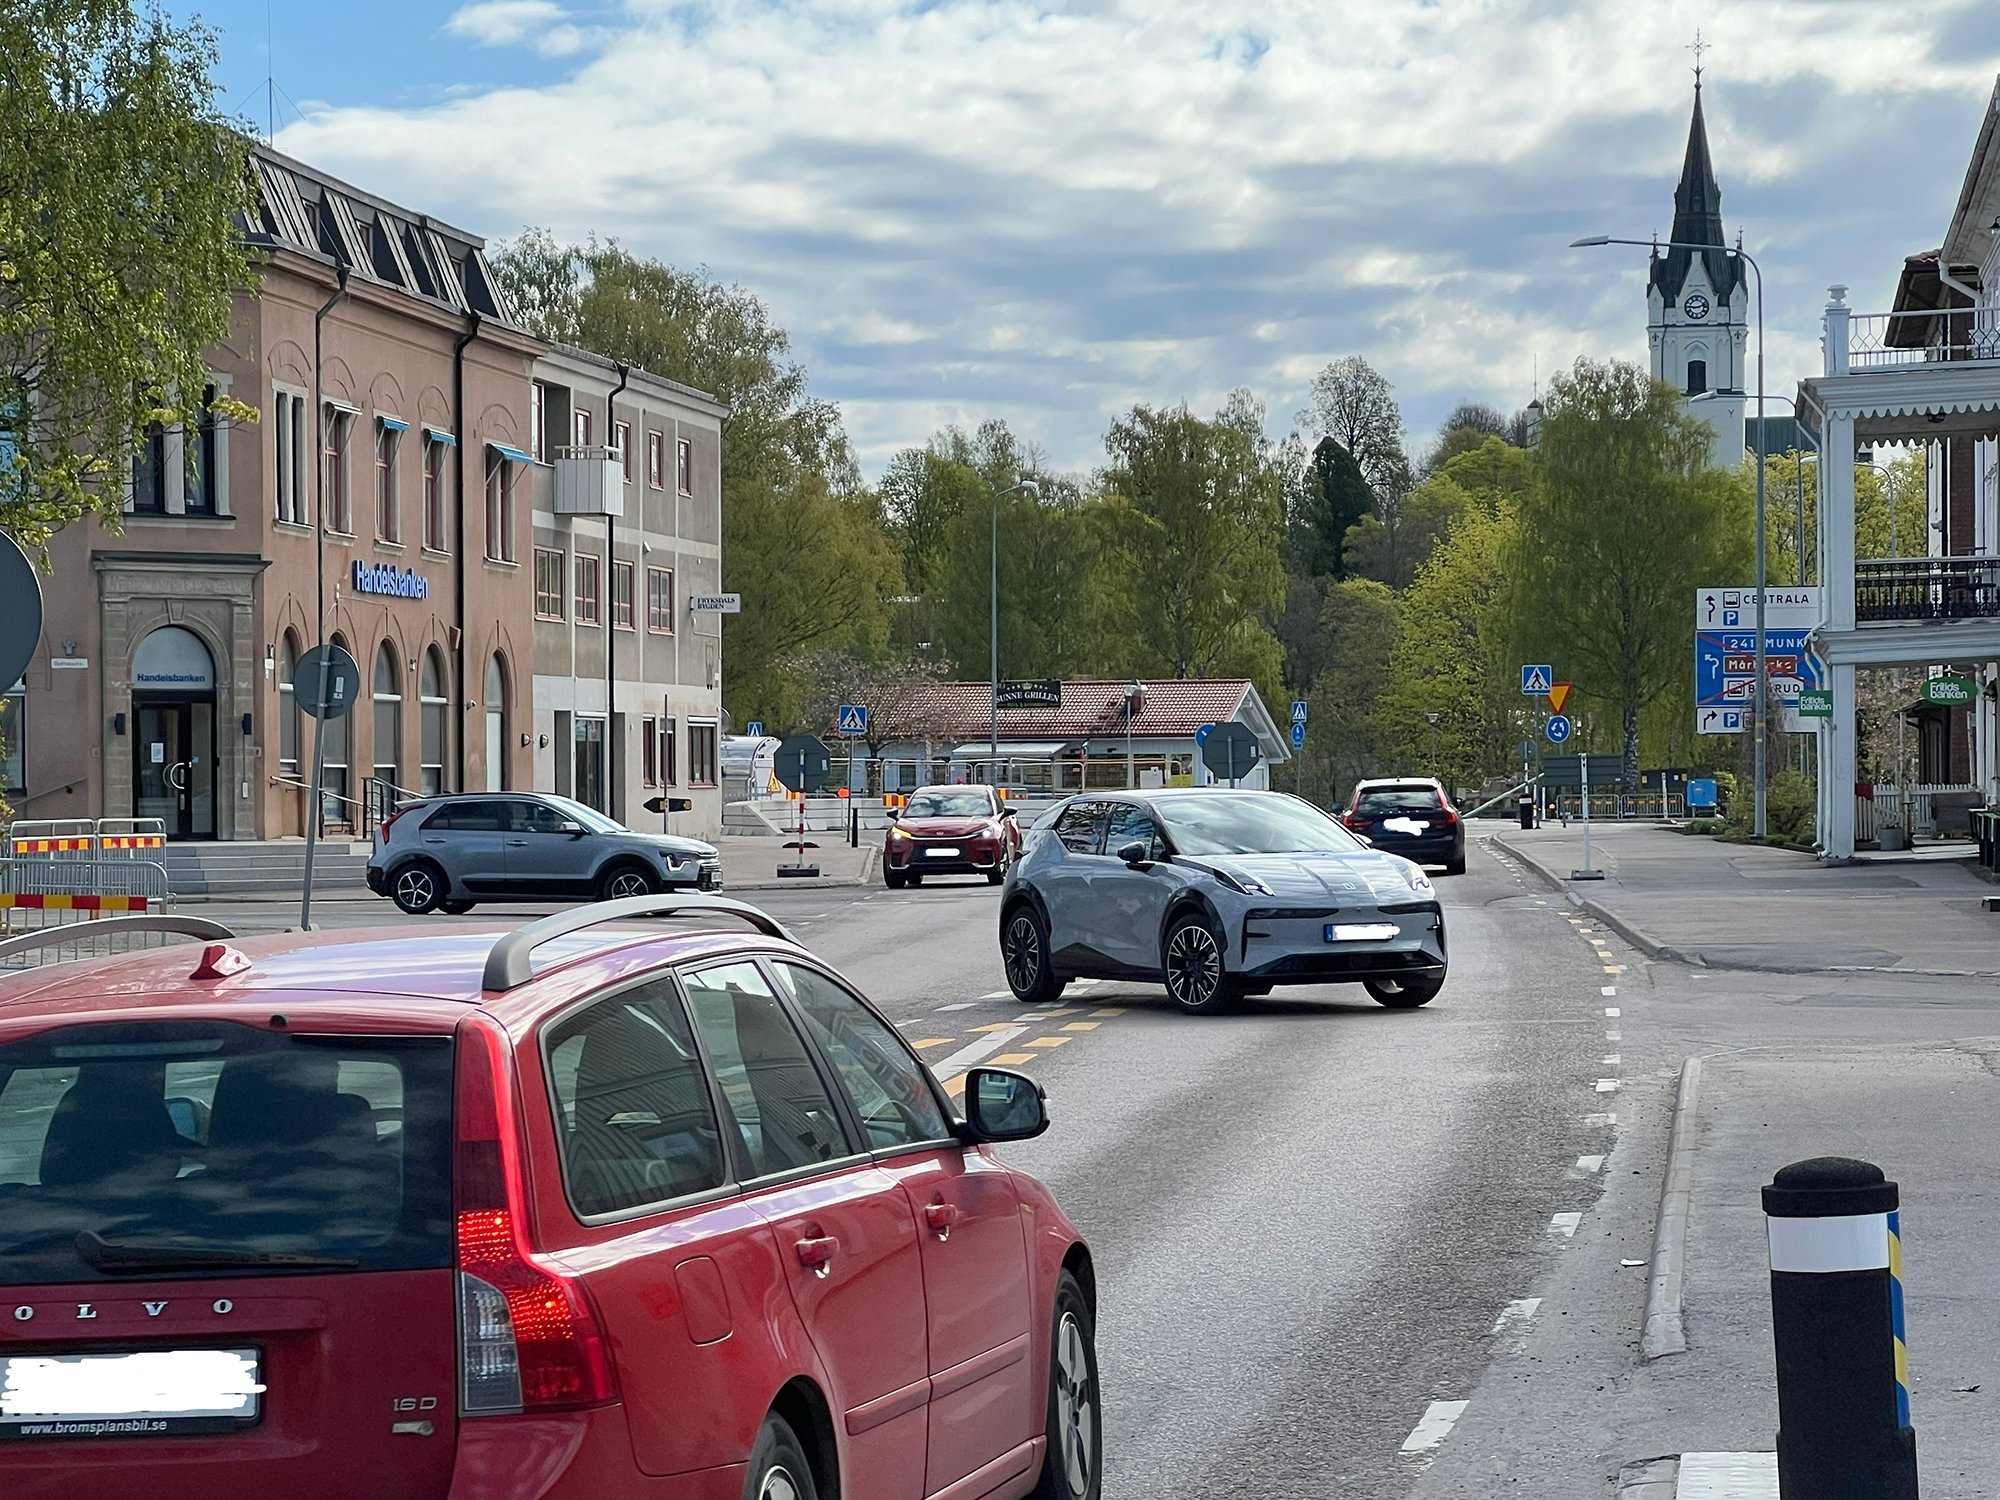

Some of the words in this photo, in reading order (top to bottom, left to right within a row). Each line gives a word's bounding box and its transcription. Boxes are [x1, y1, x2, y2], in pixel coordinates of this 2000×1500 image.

[353, 560, 428, 599] Handelsbanken
[1743, 594, 1809, 604] CETRALA
[1731, 639, 1754, 648] 241
[137, 673, 205, 682] Handelsbanken
[1930, 682, 1960, 691] Fritids
[1024, 691, 1060, 702] GRILLEN
[1930, 689, 1968, 699] banken
[1800, 702, 1832, 711] banken
[20, 1419, 168, 1436] www.bromsplansbil.se
